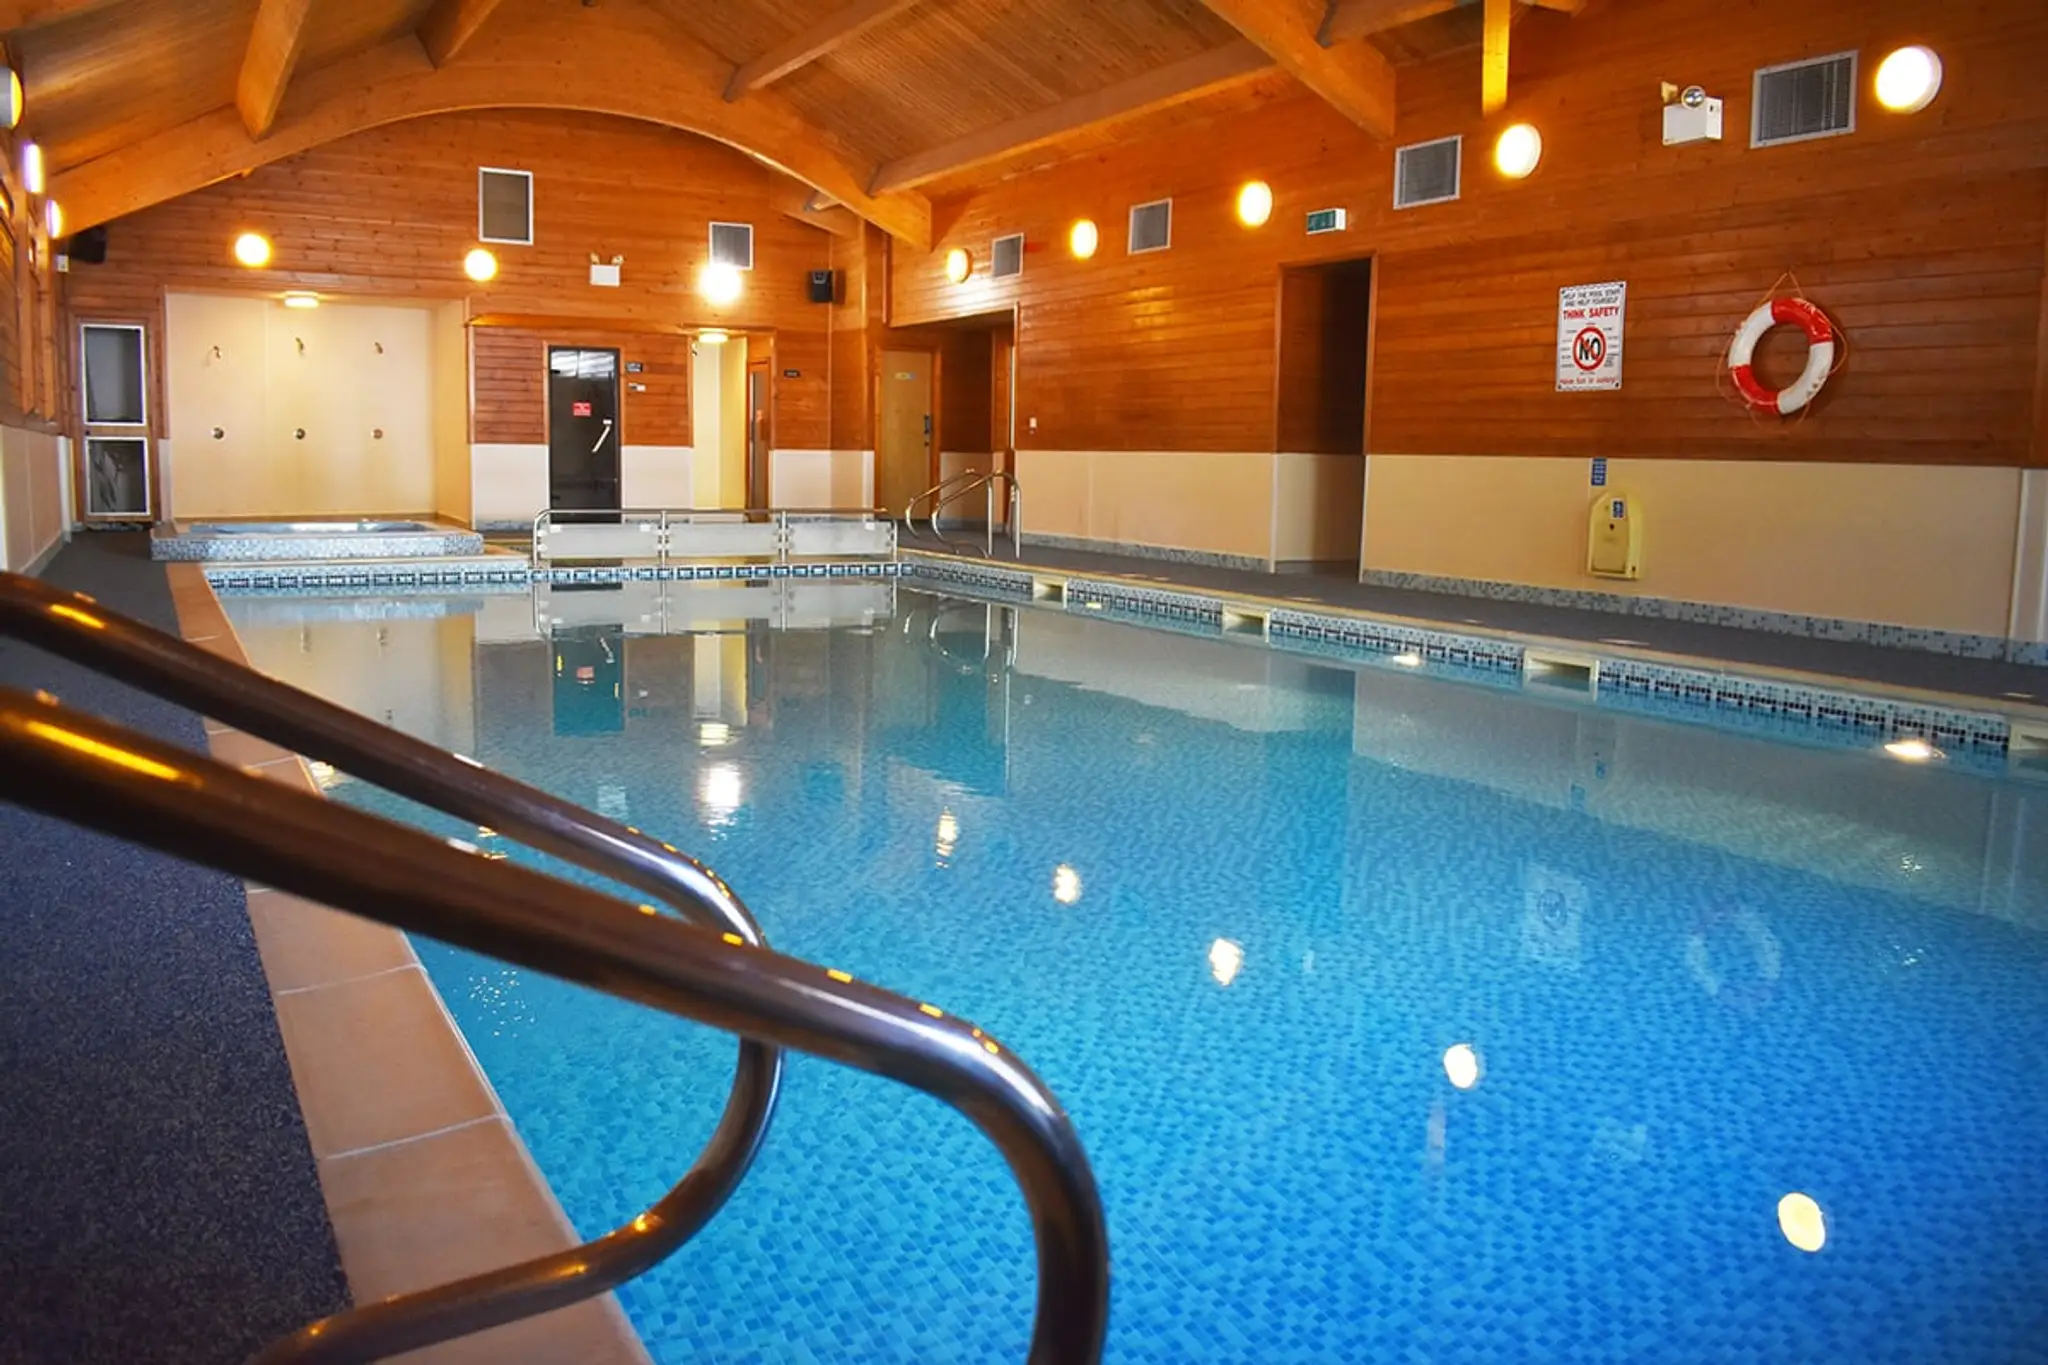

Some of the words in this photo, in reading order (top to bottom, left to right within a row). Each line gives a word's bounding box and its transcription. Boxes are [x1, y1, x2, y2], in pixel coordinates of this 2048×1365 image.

[1563, 309, 1584, 319] THINK
[1589, 307, 1619, 317] SAFETY
[1579, 337, 1601, 360] NO
